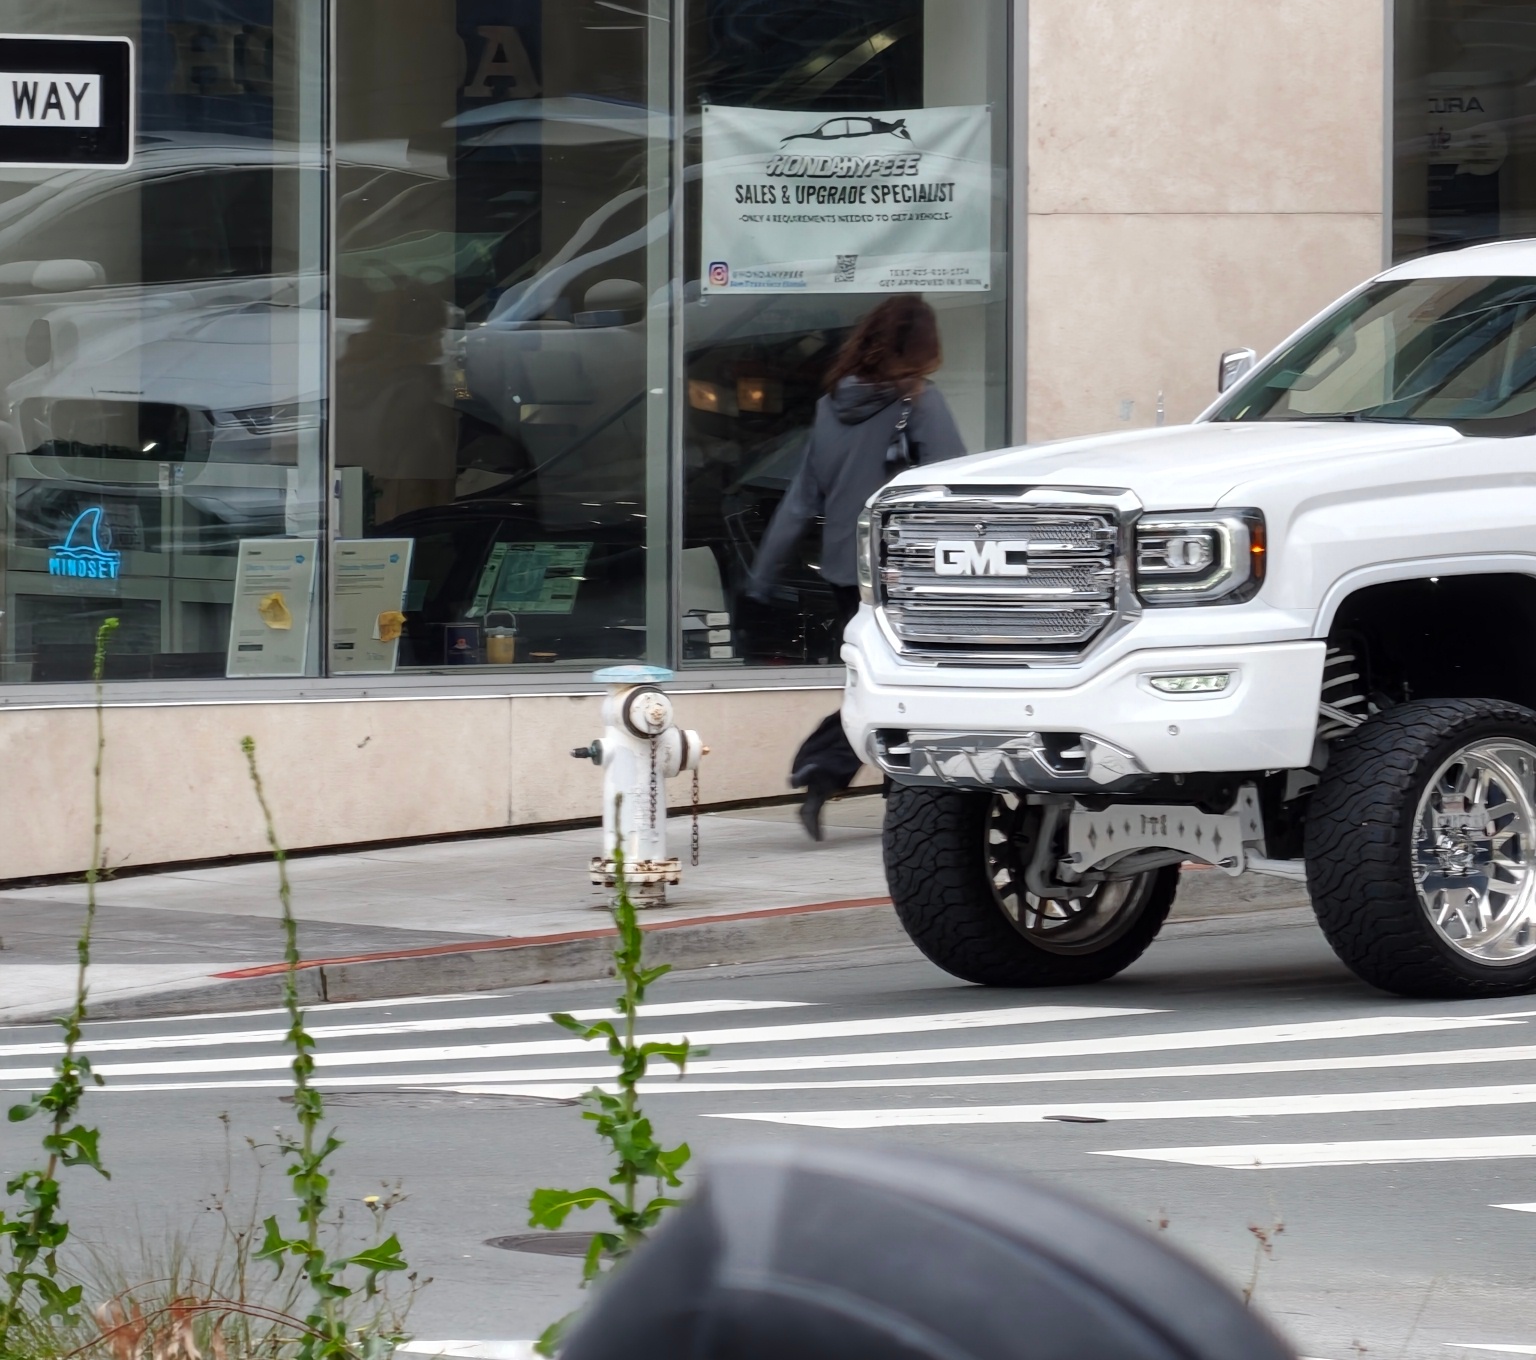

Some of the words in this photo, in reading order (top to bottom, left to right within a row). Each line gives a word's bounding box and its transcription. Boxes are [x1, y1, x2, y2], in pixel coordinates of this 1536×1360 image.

[12, 80, 91, 121] WAY
[765, 153, 923, 178] HONDAHYPEEE
[735, 184, 777, 205] SALES
[780, 185, 791, 204] &
[795, 185, 867, 205] UPGRADE
[871, 182, 955, 204] SPECIALIST
[876, 214, 889, 222] TO
[49, 558, 121, 579] MINDSET
[934, 540, 1029, 576] GMC
